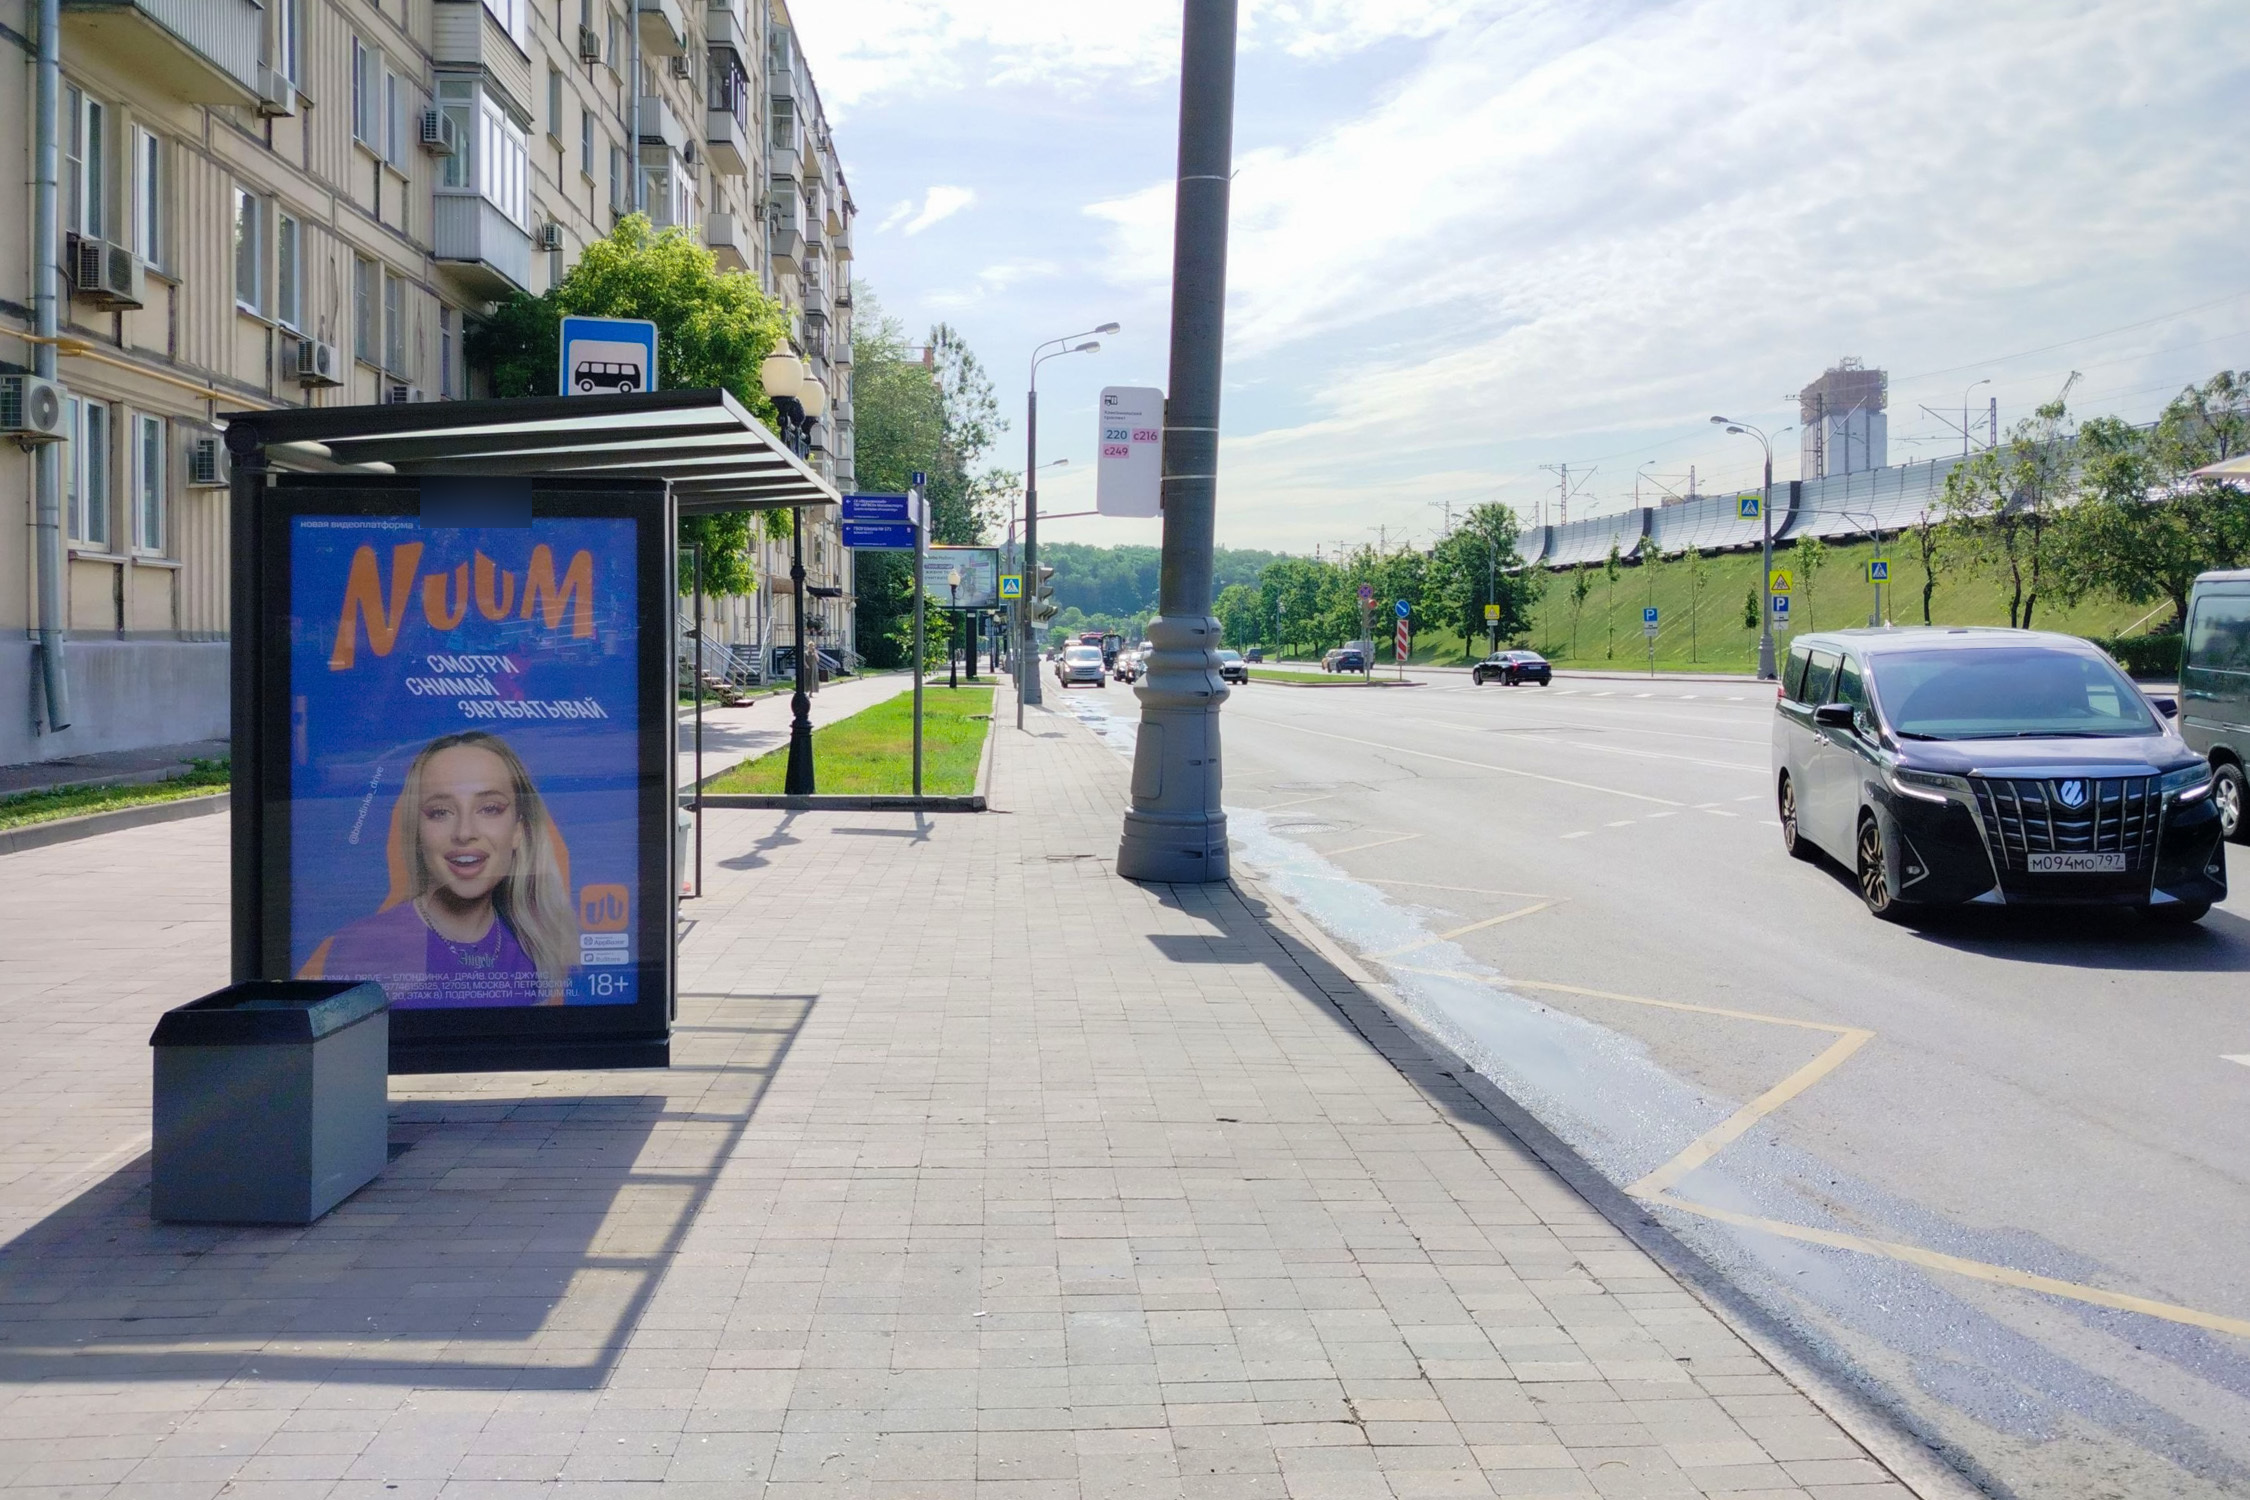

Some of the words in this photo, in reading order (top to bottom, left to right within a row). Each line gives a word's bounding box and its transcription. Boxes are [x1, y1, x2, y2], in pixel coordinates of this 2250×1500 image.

[1106, 429, 1127, 440] 220
[331, 521, 414, 531] видеоплатформа
[426, 654, 520, 674] СМОТРИ
[405, 674, 500, 697] СНИМАЙ
[458, 697, 609, 720] ЗАРАБАТЫВАЙ
[348, 766, 384, 845] @blondinka_drive
[2032, 856, 2095, 870] М094МО
[2097, 854, 2120, 866] 797
[488, 971, 508, 980] ООО
[514, 977, 573, 989] ПЕТРОВСКИЙ
[588, 973, 629, 996] 18+
[407, 991, 431, 1000] ЭТАЖ
[445, 990, 513, 1000] ПОДРОБНОСТИ
[524, 988, 537, 998] НА
